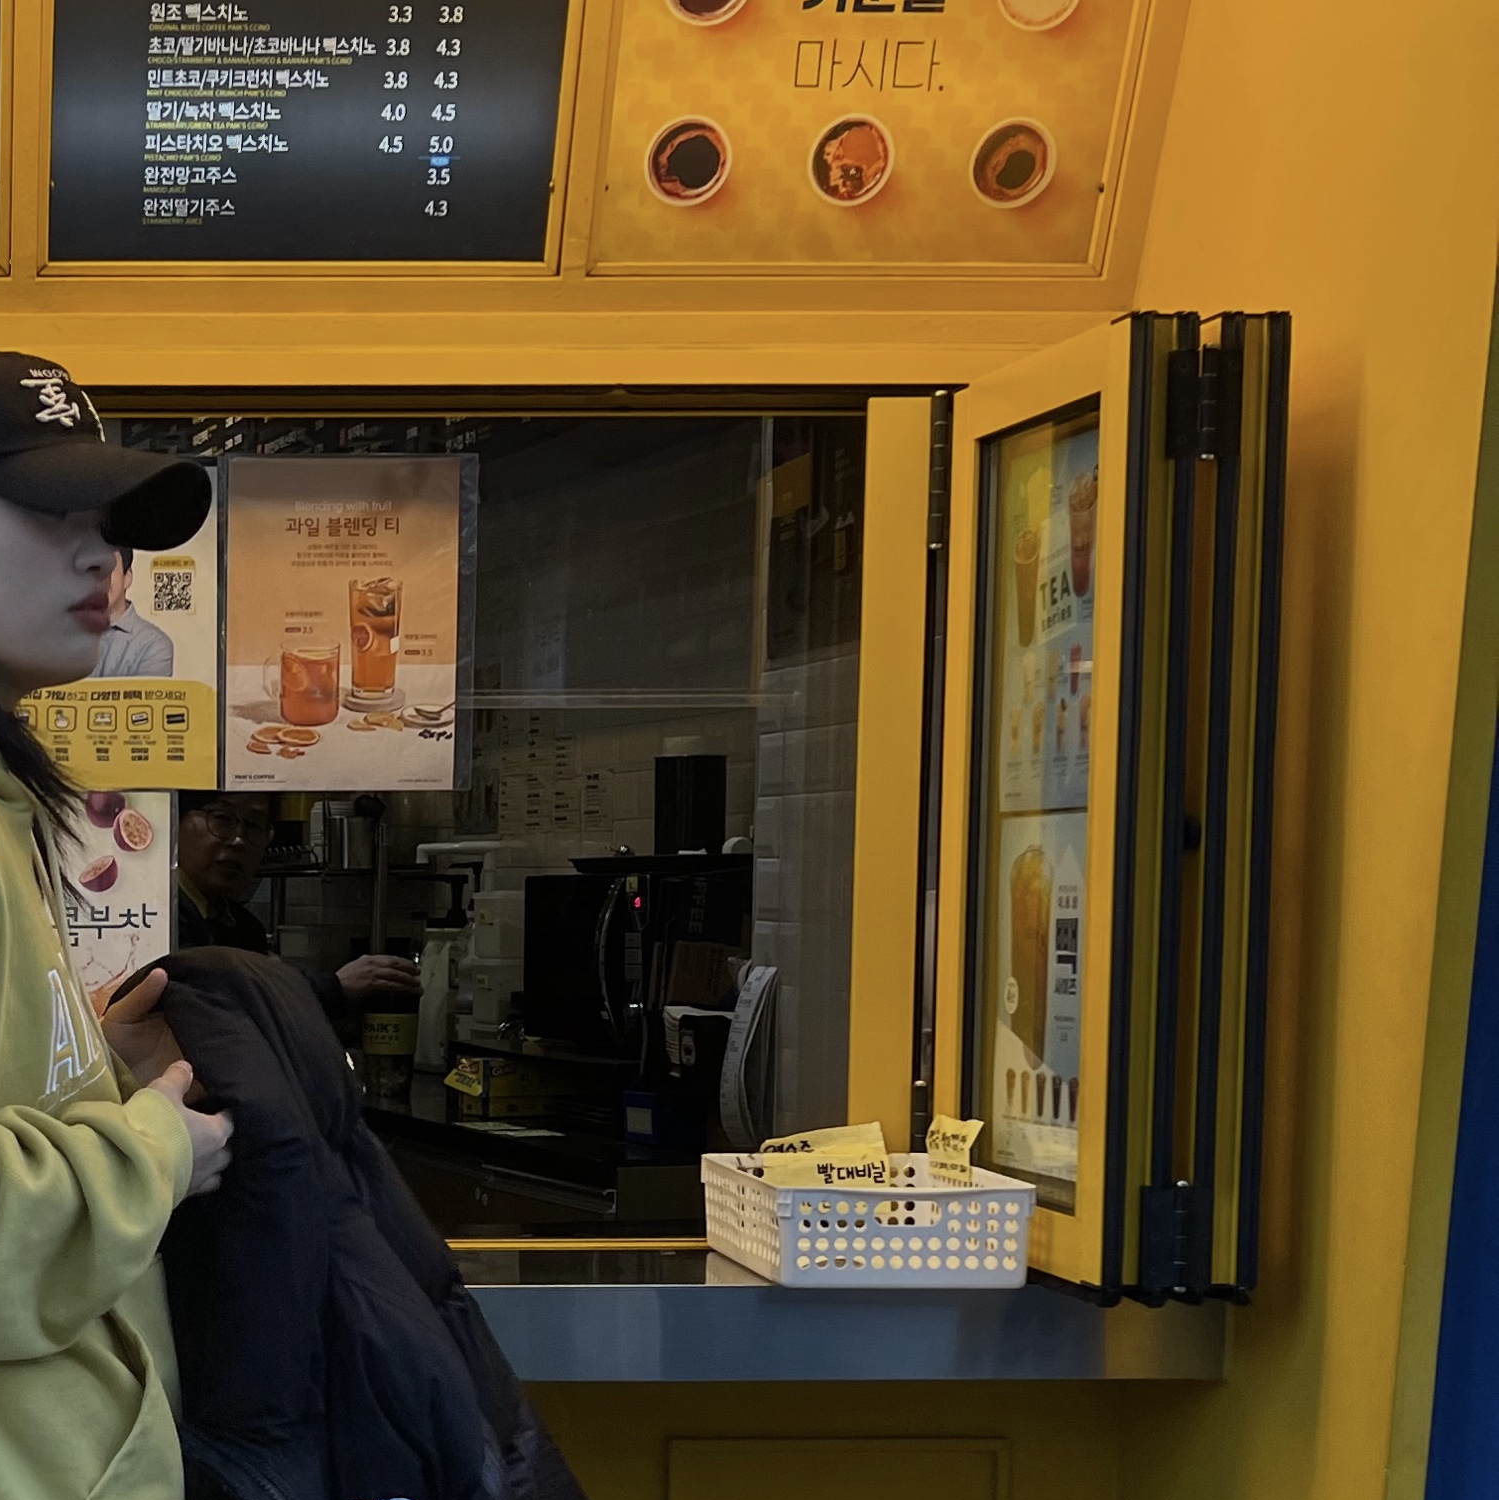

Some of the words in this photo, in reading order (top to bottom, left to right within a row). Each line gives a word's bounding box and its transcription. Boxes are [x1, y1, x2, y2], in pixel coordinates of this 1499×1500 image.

[150, 3, 181, 22] 원조
[185, 3, 249, 22] 빽스치노
[388, 5, 413, 23] 3.3
[439, 6, 464, 23] 3.8
[148, 36, 321, 58] 초코/딸기바나나/초코바나나
[386, 38, 411, 56] 3.8
[436, 38, 461, 57] 4.3
[794, 39, 944, 92] 마시다.
[147, 68, 273, 90] 민트초코/쿠키크런치
[276, 69, 330, 89] 빽스치노
[383, 71, 409, 89] 3.8
[434, 71, 458, 89] 4.3
[146, 101, 216, 122] 딸기/녹차
[219, 101, 281, 121] 빽스치노
[381, 103, 407, 122] 4.0
[431, 103, 456, 122] 4.5
[144, 133, 223, 153] 피스타치오
[226, 133, 289, 153] 빽스치노
[378, 135, 404, 153] 4.5
[429, 136, 454, 153] 5.0
[144, 166, 237, 185] 완전망고주스
[426, 168, 450, 185] 3.5
[143, 198, 236, 217] 완전딸기주스
[424, 200, 448, 217] 4.3
[285, 517, 319, 537] 과일
[326, 517, 377, 537] 블렌딩
[384, 517, 400, 535] 티
[1039, 570, 1071, 611] TEA
[1041, 605, 1072, 633] series
[45, 690, 88, 701] 가입하고
[817, 1160, 886, 1185] 빨대비닐
